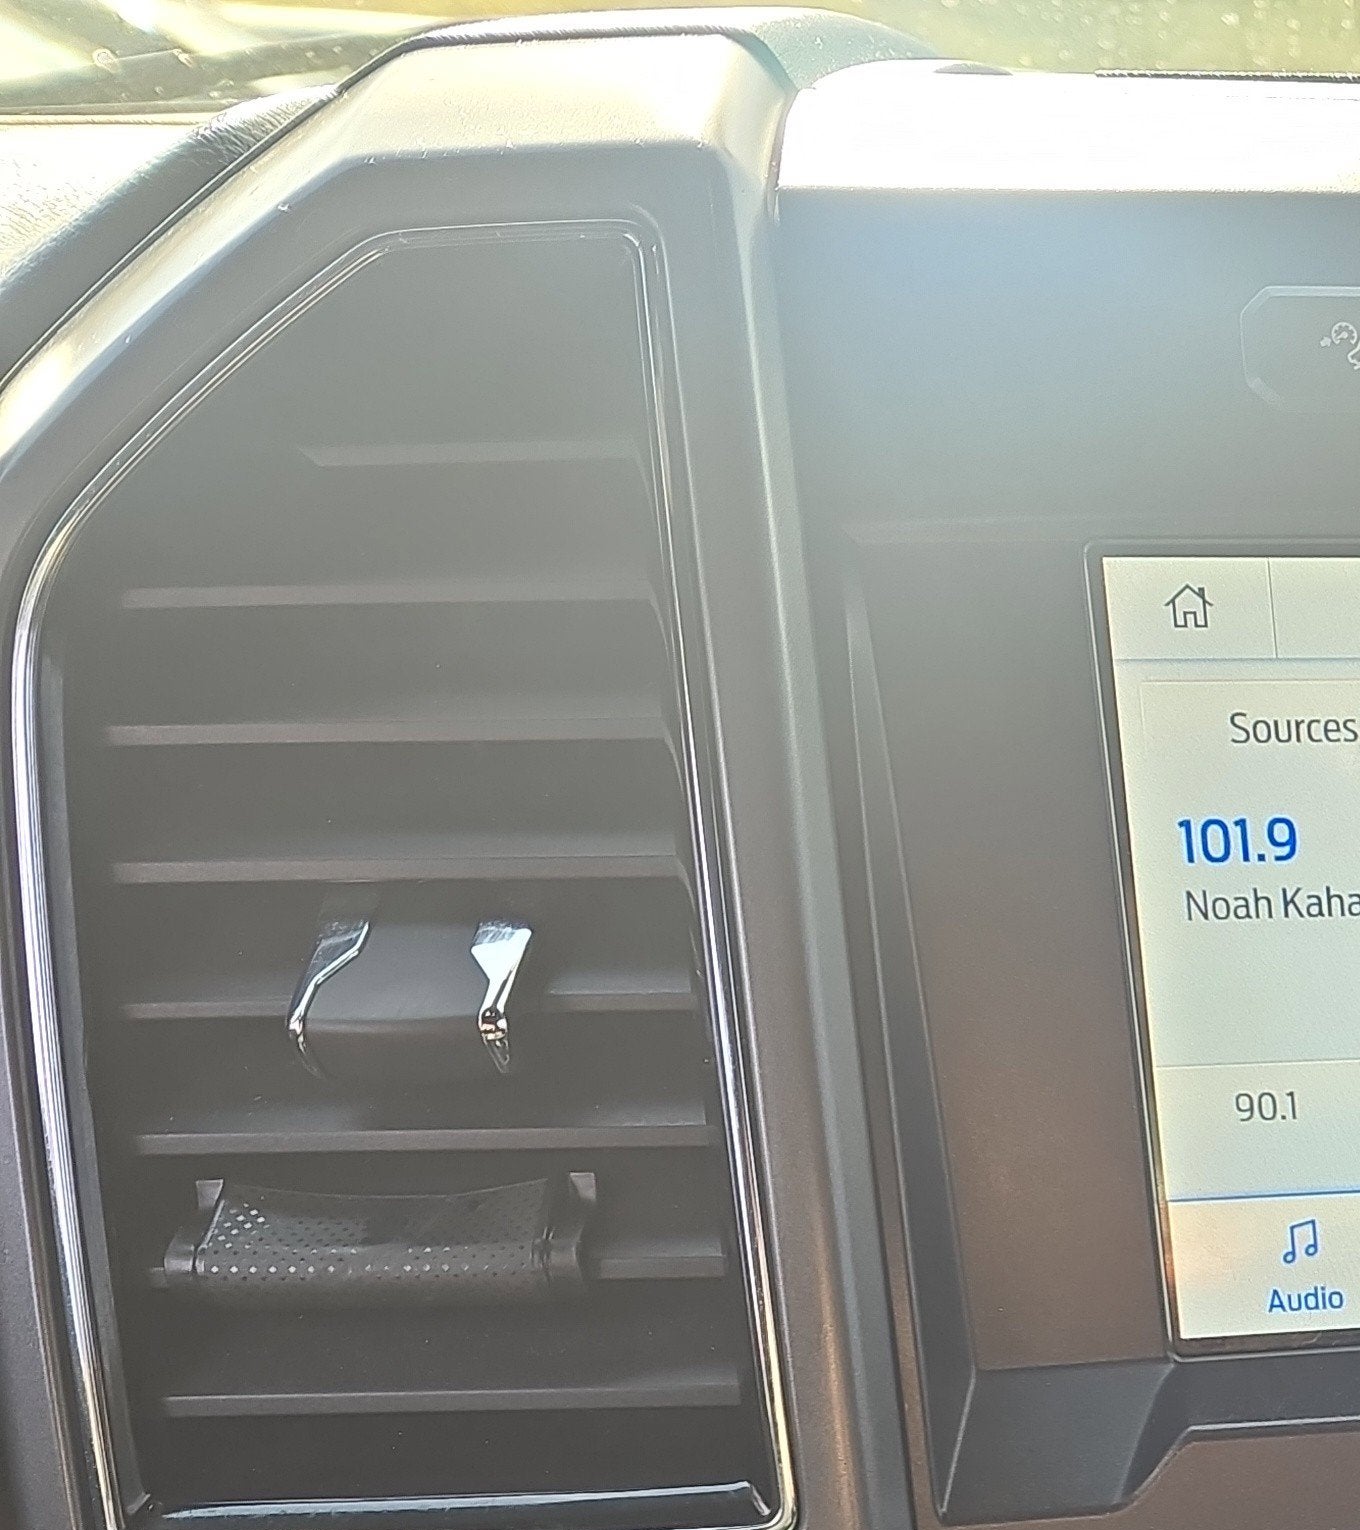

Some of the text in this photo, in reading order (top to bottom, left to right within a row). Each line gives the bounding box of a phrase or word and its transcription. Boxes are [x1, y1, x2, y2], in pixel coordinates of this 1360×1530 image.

[1229, 712, 1359, 745] Sources
[1177, 817, 1298, 863] 101.9
[1185, 886, 1275, 921] Noah
[1234, 1091, 1298, 1122] 90.1
[1268, 1286, 1344, 1313] Audio
